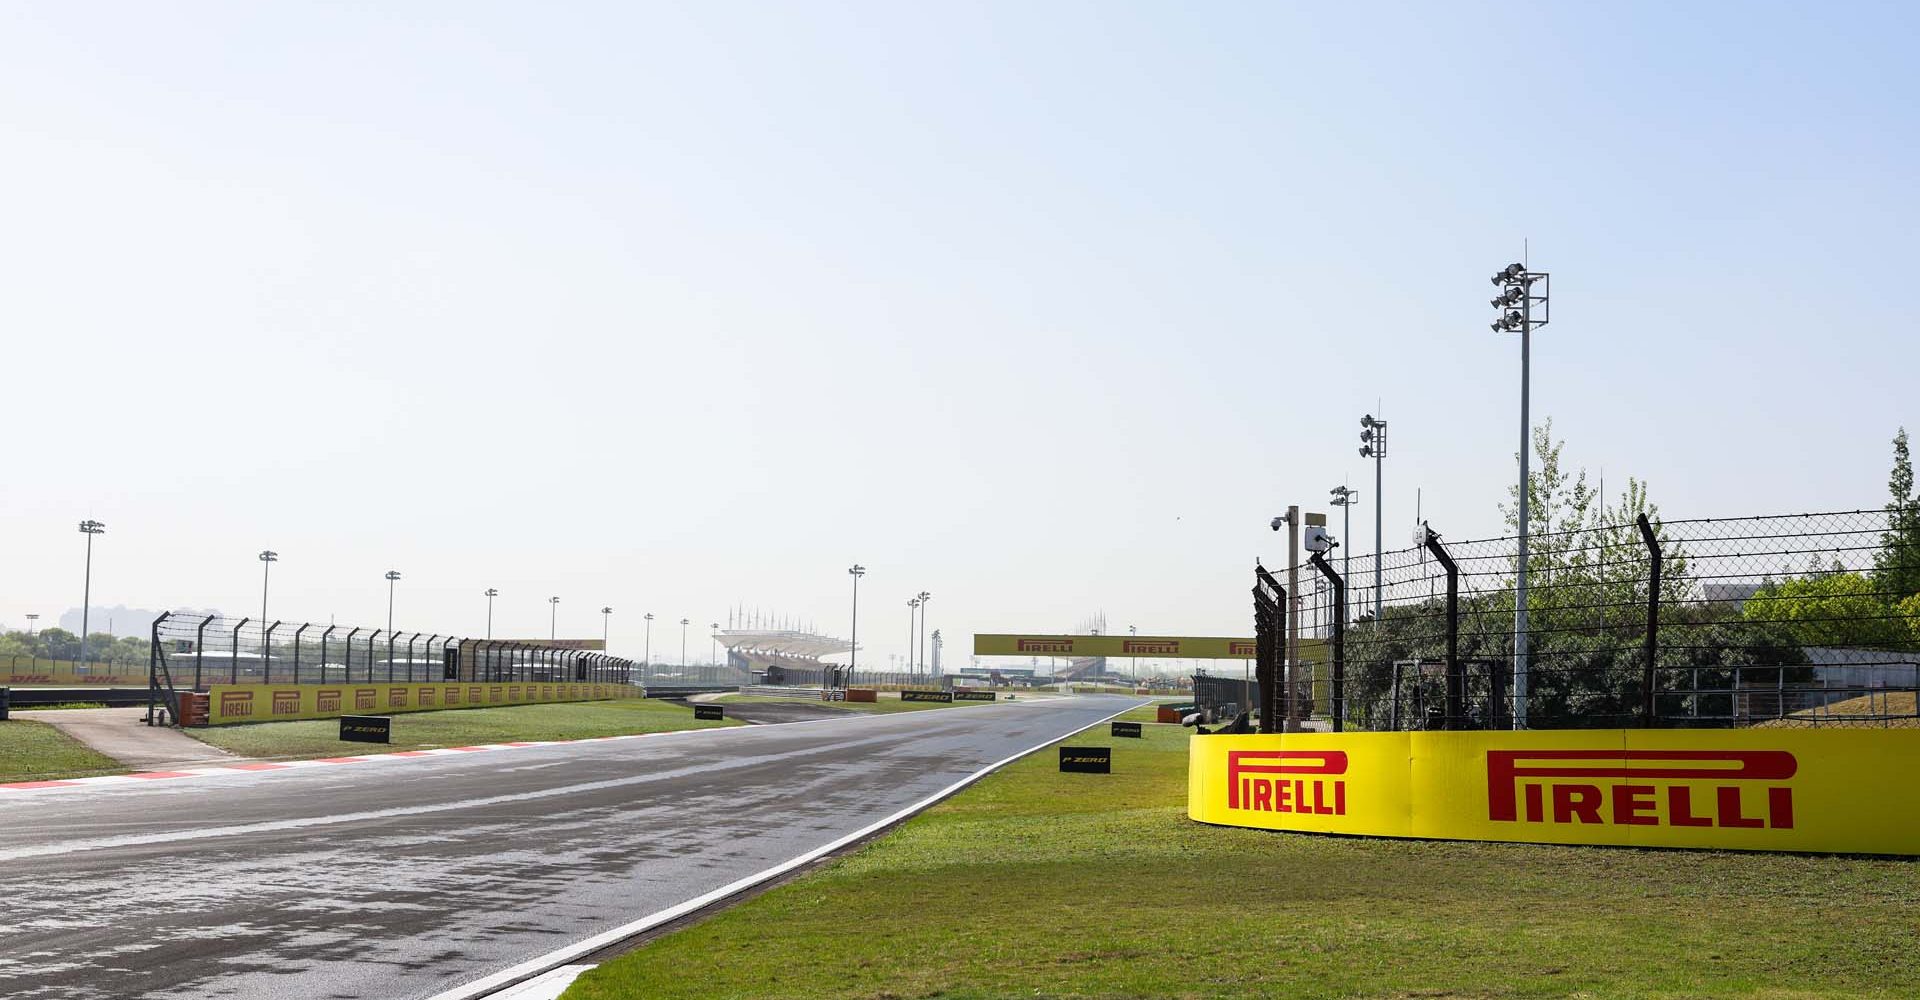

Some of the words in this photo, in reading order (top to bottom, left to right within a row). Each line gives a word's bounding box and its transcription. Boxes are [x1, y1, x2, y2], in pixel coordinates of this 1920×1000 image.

[1018, 639, 1073, 652] PIRELLI
[1123, 640, 1179, 653] PIRELLI
[221, 691, 253, 717] PIRELLI
[273, 690, 301, 715] PIRELLI
[317, 690, 342, 712] PIRELLI
[1228, 751, 1348, 816] PIRELLI
[1486, 750, 1798, 829] PIRELLI
